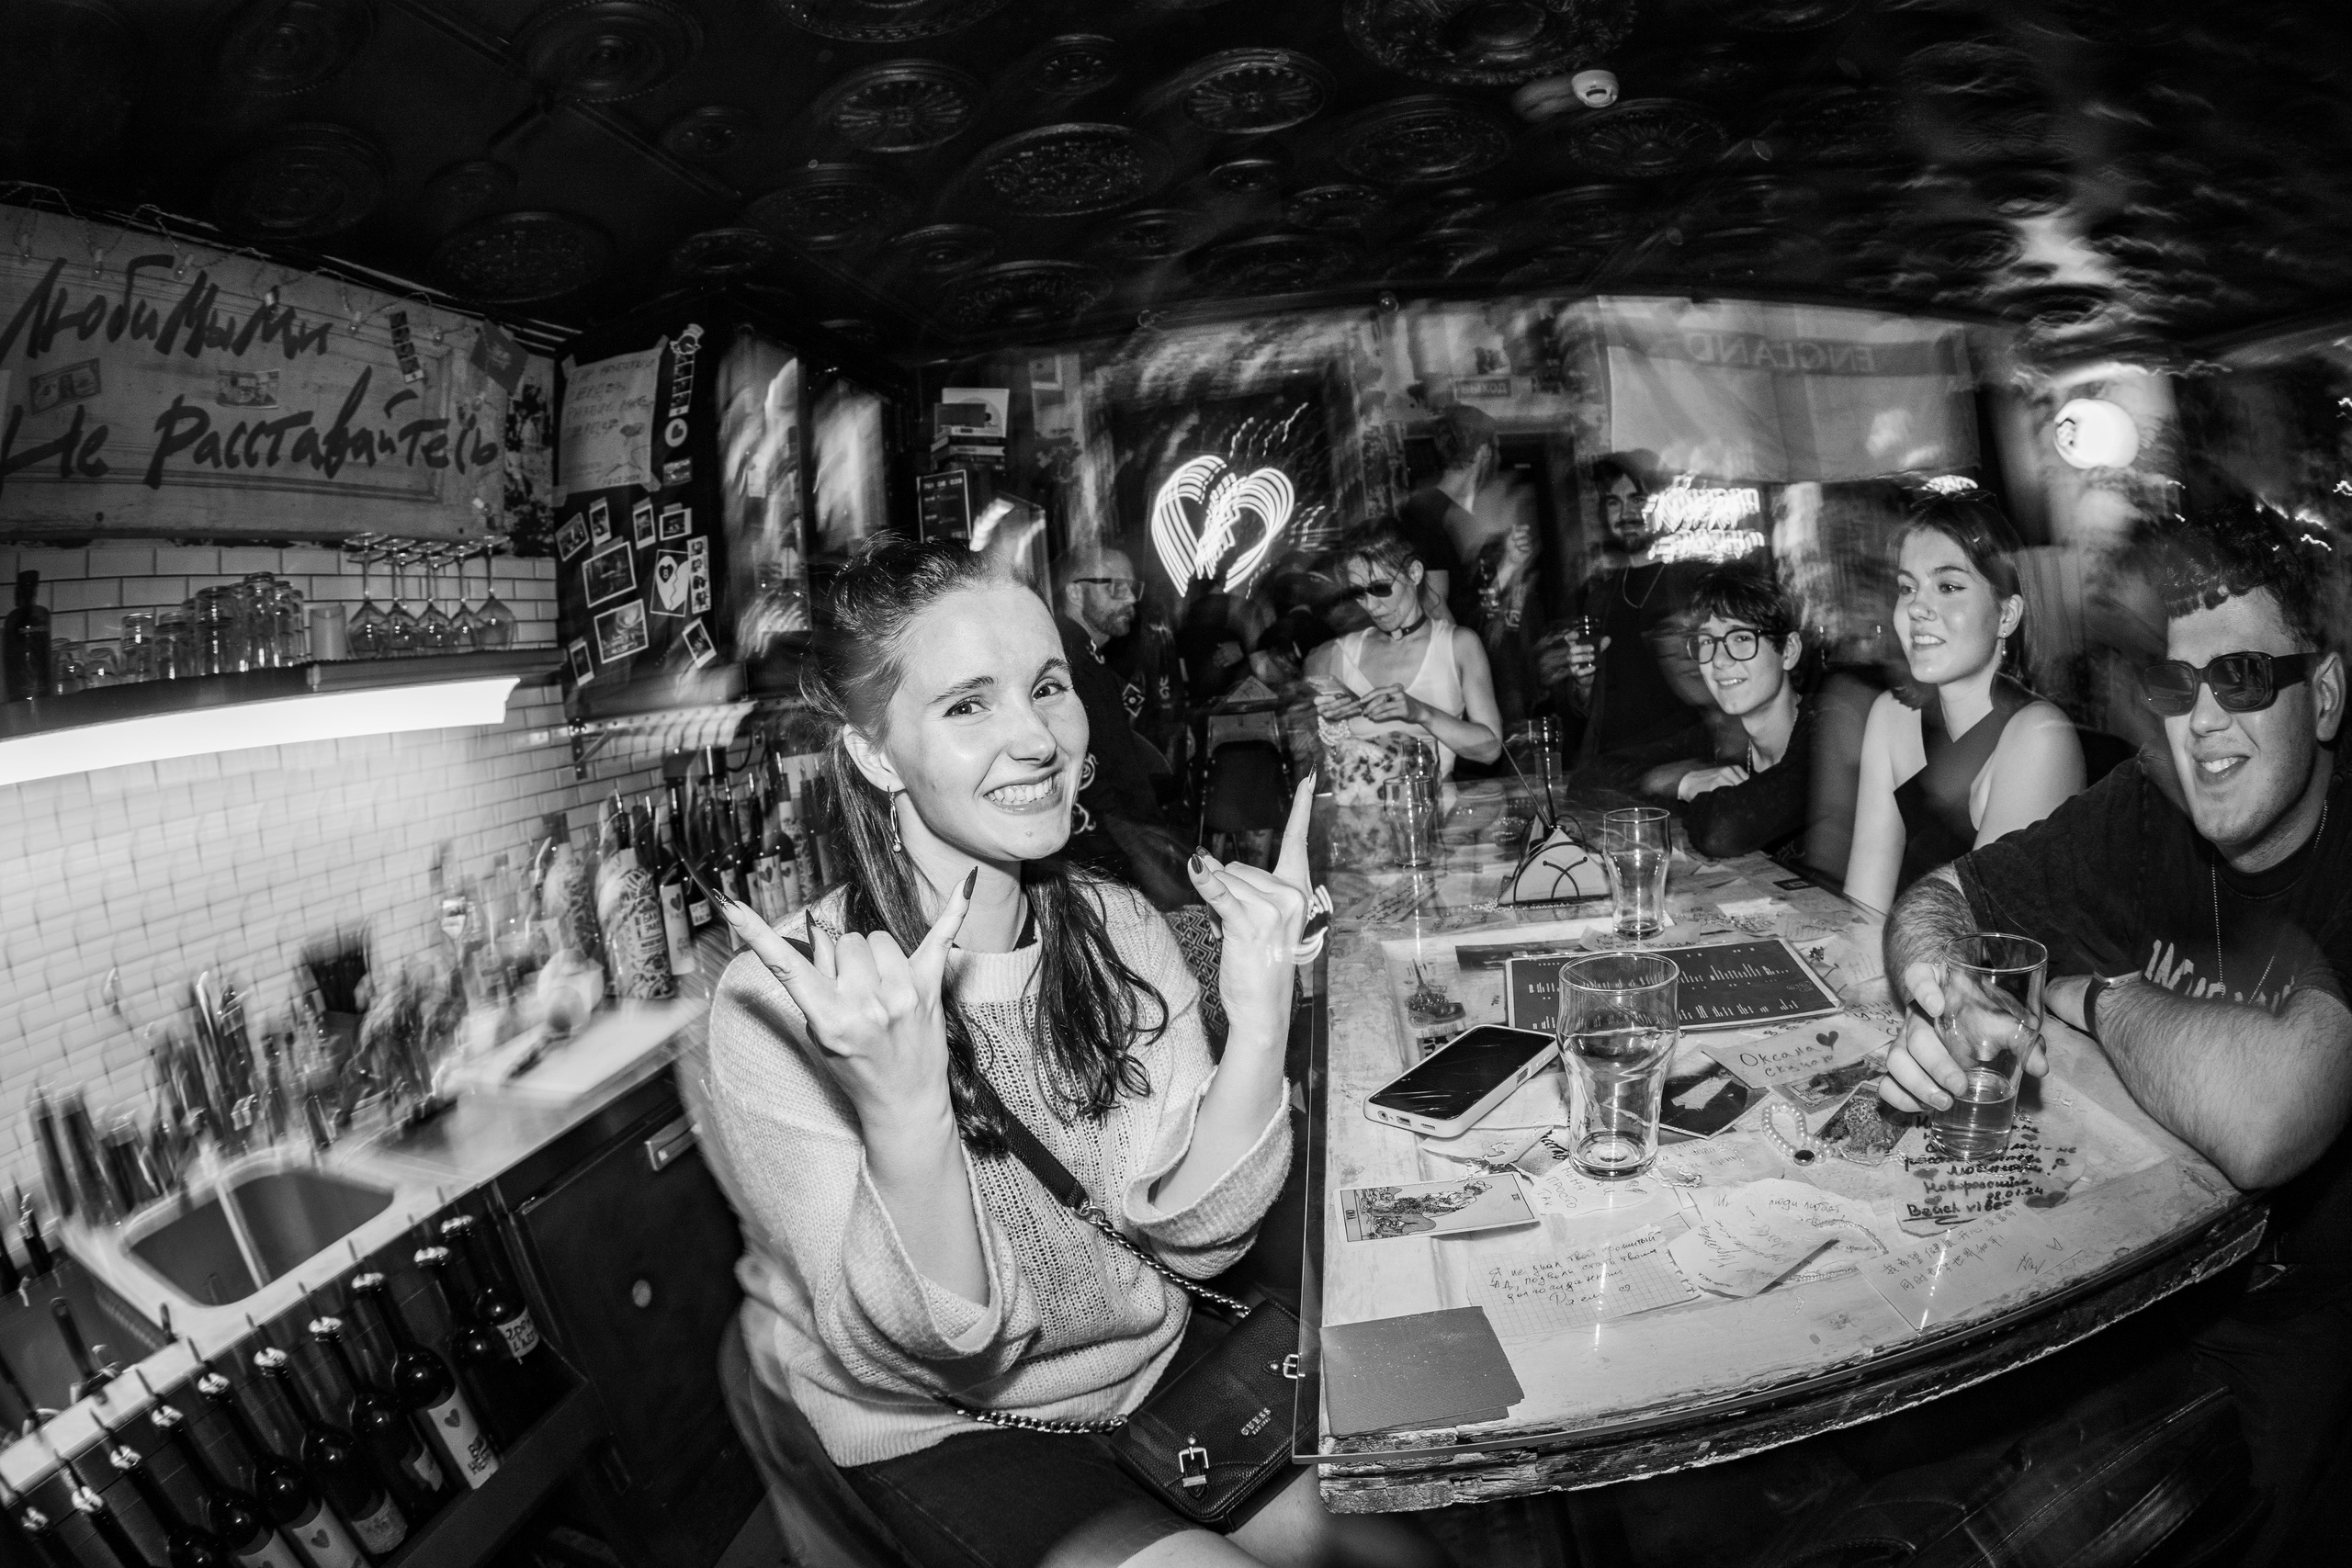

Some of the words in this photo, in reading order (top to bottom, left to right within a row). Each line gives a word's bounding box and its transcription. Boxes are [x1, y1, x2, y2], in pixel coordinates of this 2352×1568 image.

[1739, 1043, 1822, 1067] Оксана
[1489, 1267, 1501, 1282] Я
[1511, 1269, 1526, 1277] не
[1240, 1407, 1272, 1436] GUESS
